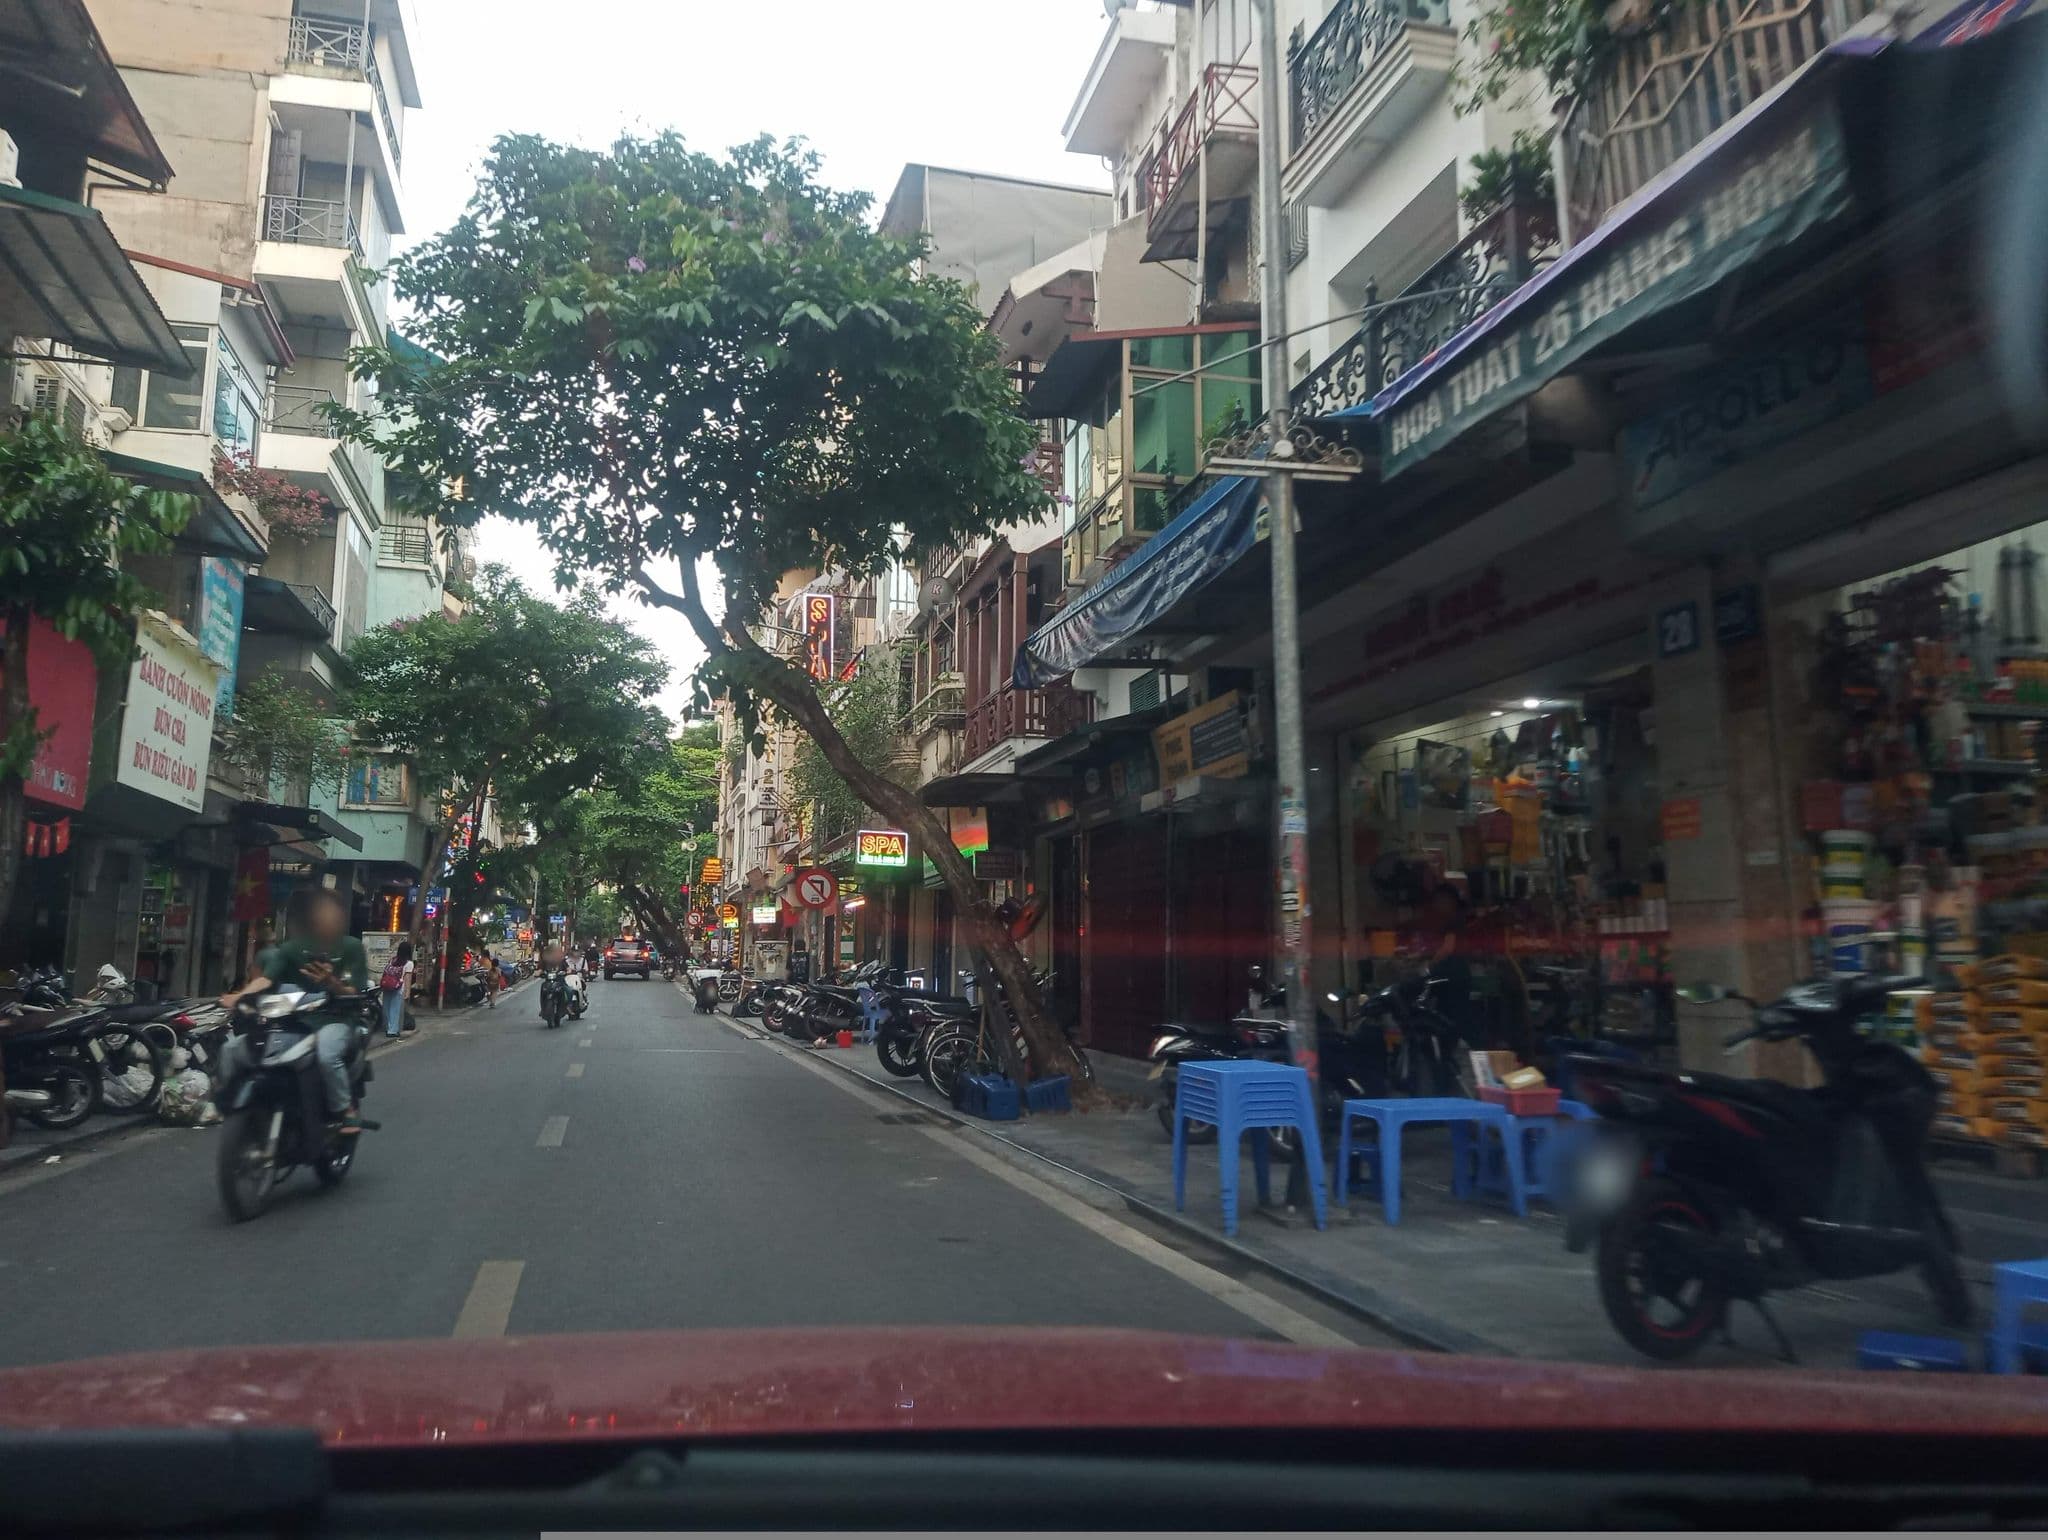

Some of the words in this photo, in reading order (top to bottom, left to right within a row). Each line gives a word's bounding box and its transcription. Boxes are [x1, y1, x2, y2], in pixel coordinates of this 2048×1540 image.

[166, 669, 189, 706] CUỐN
[154, 704, 172, 738] BÚN
[133, 737, 152, 776] BÚN
[861, 835, 904, 855] SPA
